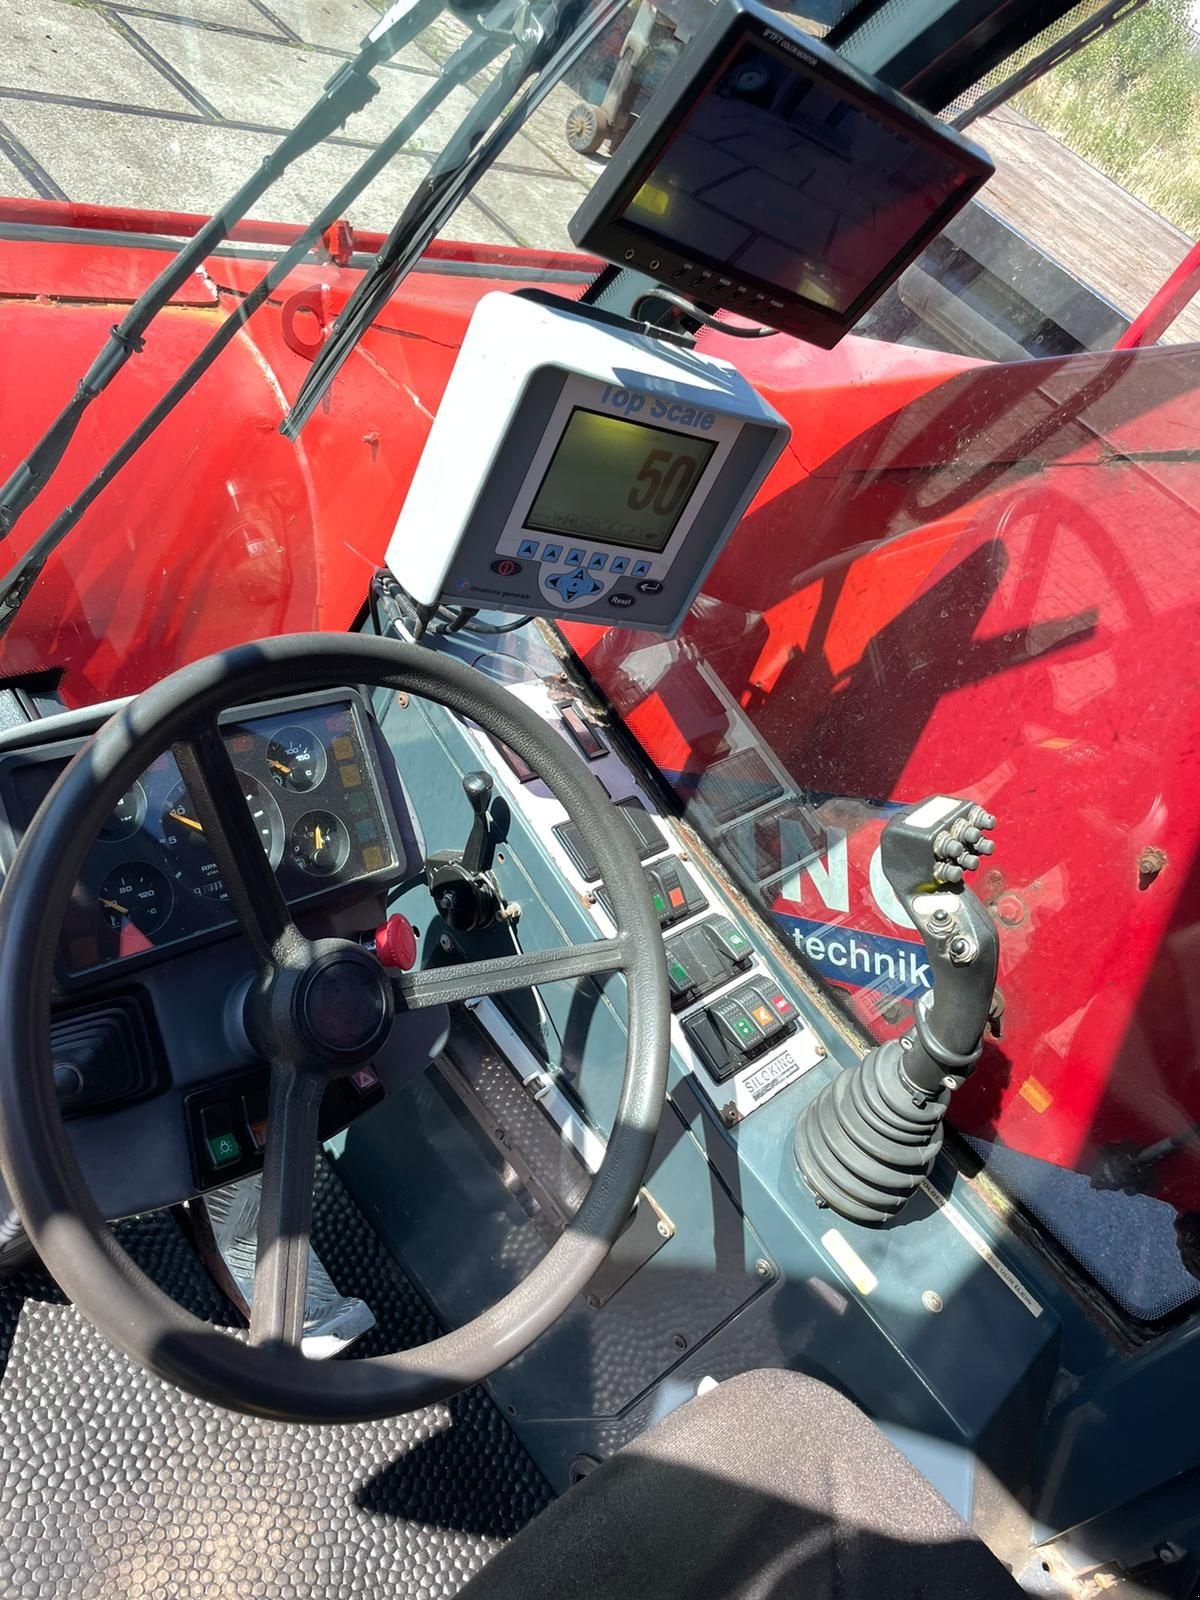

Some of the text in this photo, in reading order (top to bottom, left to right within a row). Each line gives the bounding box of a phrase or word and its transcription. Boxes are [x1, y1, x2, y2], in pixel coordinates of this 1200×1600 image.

[600, 385, 716, 431] Top Scale
[627, 449, 696, 515] 50
[611, 596, 632, 606] Reset
[285, 747, 299, 755] 100
[295, 753, 310, 761] 150
[168, 835, 177, 845] 5
[119, 885, 133, 894] 80
[137, 889, 155, 899] 120
[792, 927, 931, 989] technik
[744, 1052, 795, 1094] SILOKING
